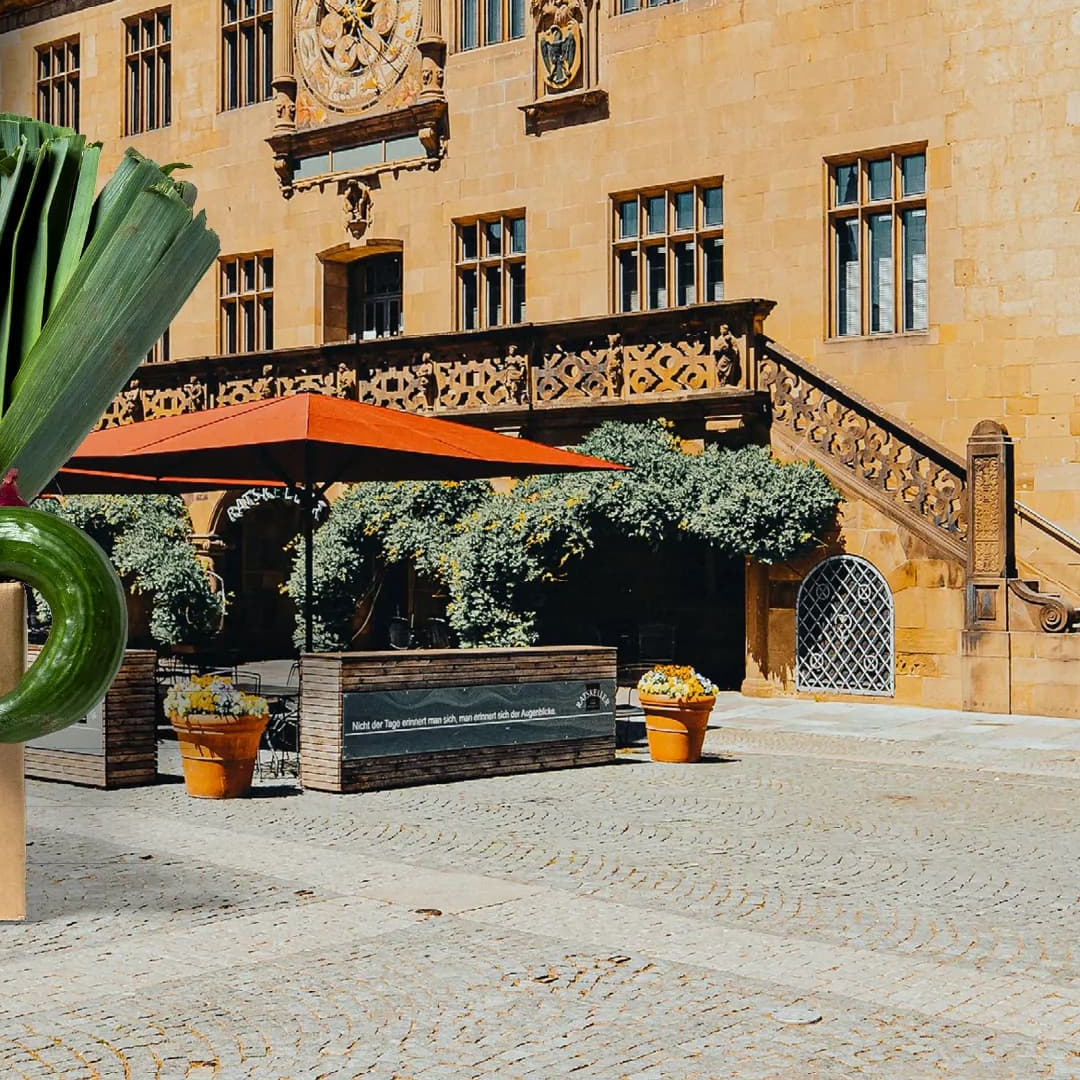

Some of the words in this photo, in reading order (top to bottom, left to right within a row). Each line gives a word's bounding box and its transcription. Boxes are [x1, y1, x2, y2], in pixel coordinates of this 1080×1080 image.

[352, 720, 371, 731] Nicht
[371, 719, 384, 730] der
[401, 716, 427, 728] erinnert
[427, 716, 442, 725] man
[459, 713, 473, 723] man
[473, 711, 497, 722] erinnert
[497, 709, 510, 720] sich
[511, 709, 521, 719] der
